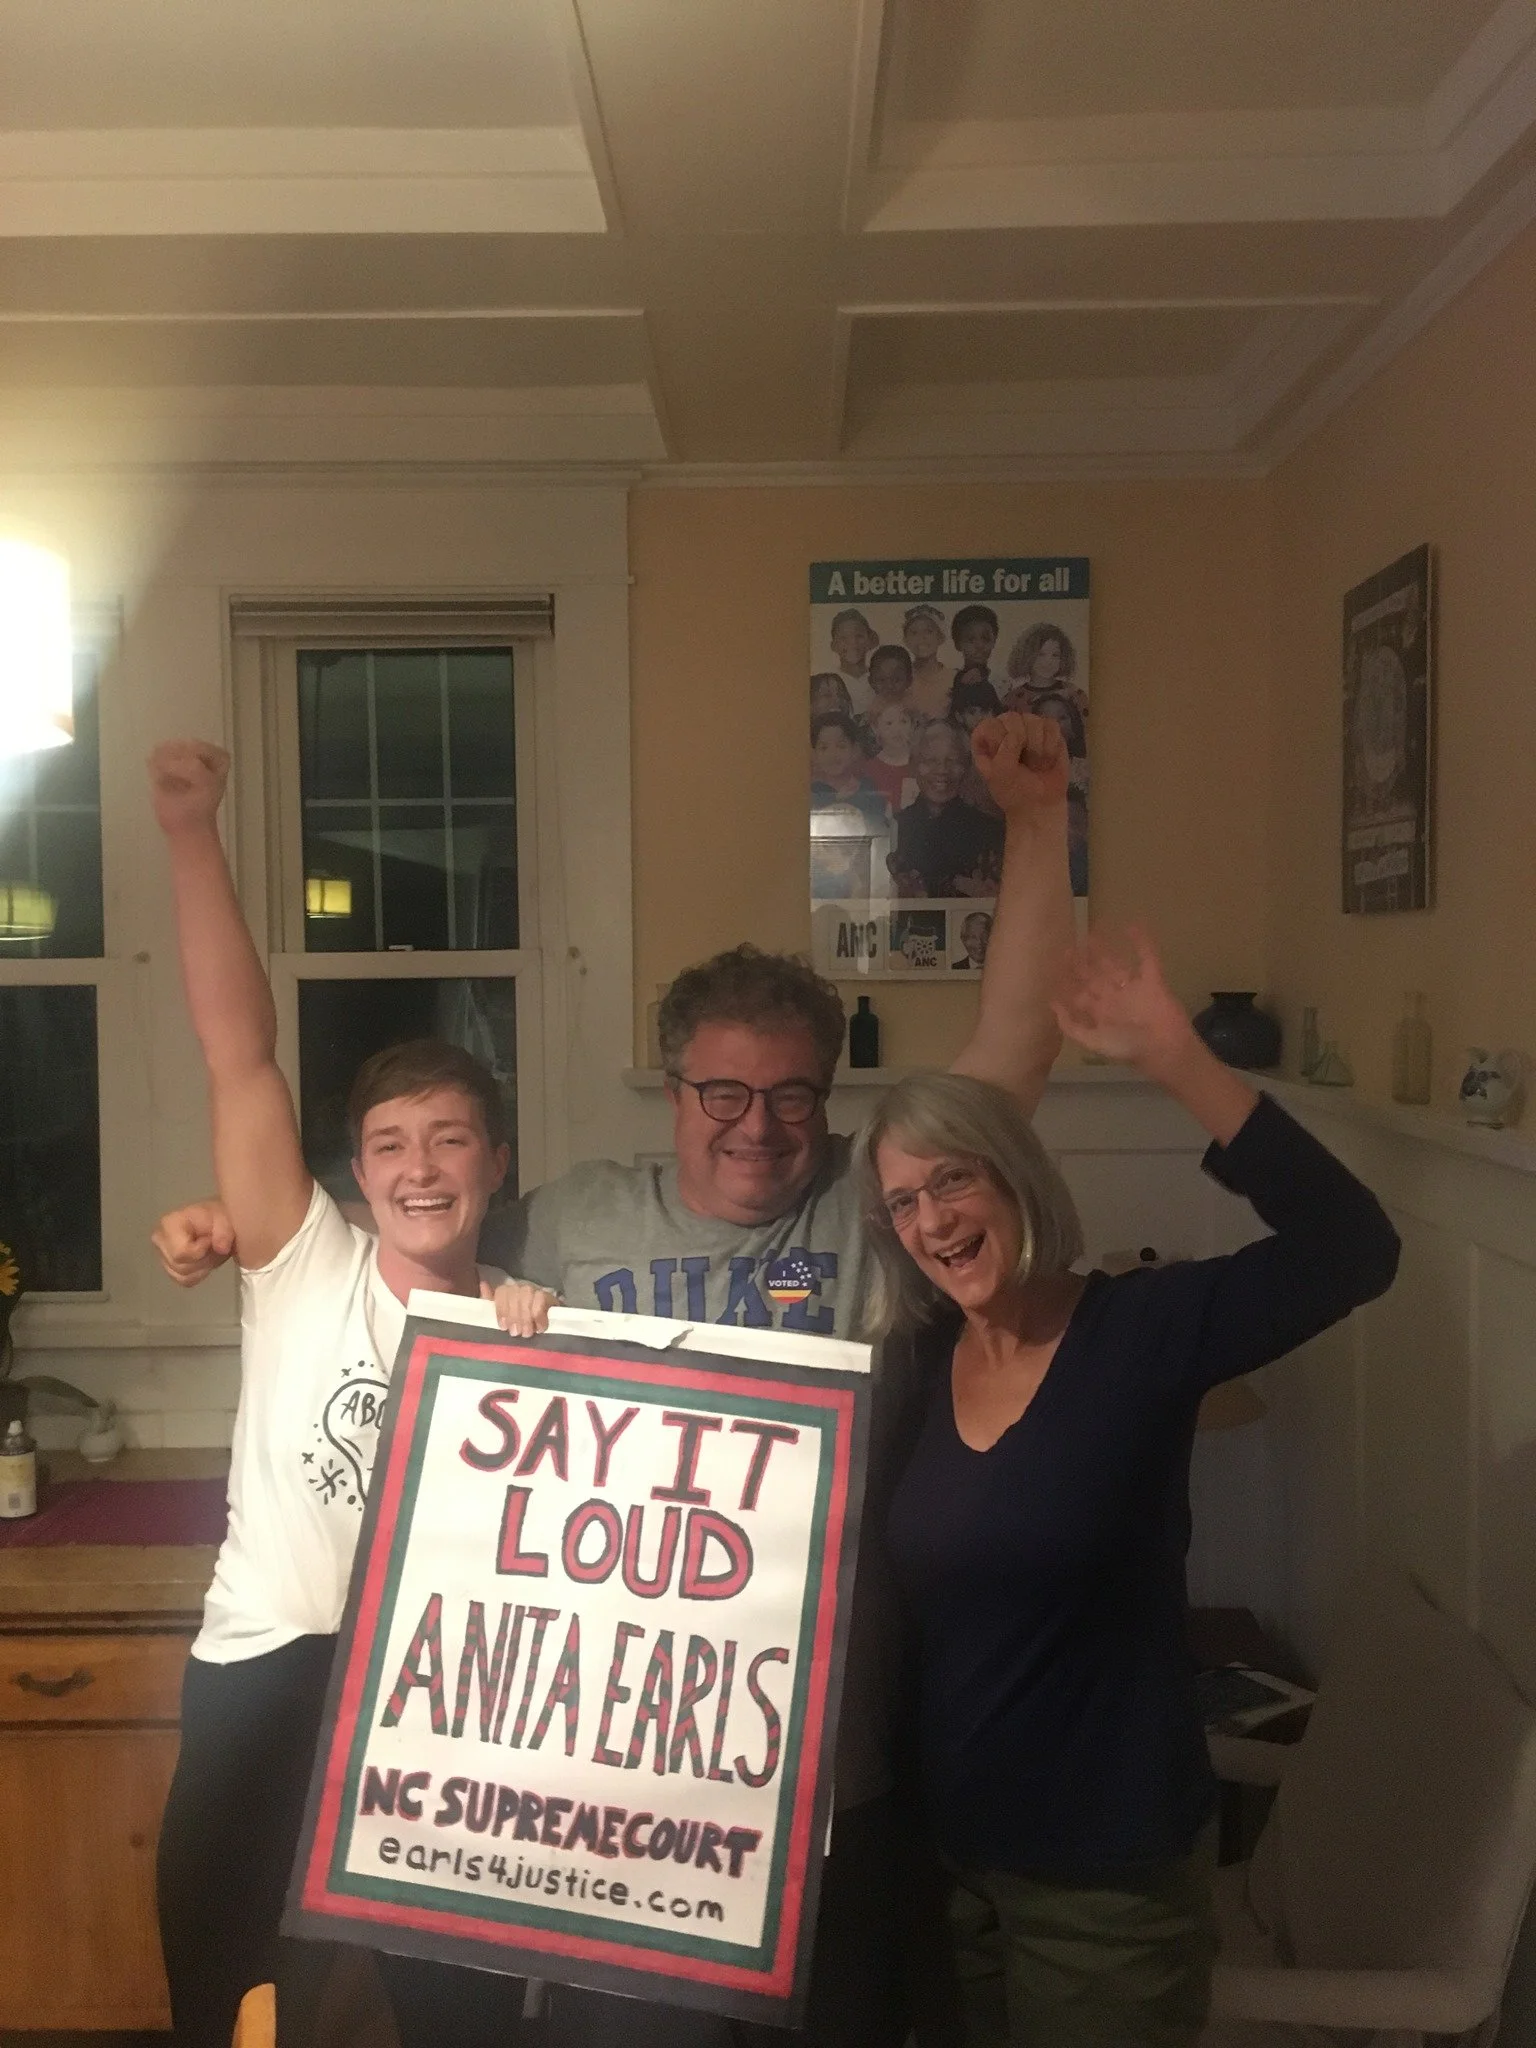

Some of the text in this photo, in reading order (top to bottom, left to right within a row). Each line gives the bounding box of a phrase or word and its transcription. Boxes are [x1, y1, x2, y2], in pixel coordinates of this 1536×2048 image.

[828, 567, 1070, 596] A better life for all
[837, 922, 877, 958] ANC
[915, 957, 938, 967] ANC
[460, 1388, 798, 1510] SAY IT
[496, 1484, 754, 1601] LOUD
[381, 1592, 790, 1788] ANITA EARLS
[360, 1765, 431, 1820] NC
[379, 1836, 725, 1922] earls4justice.com
